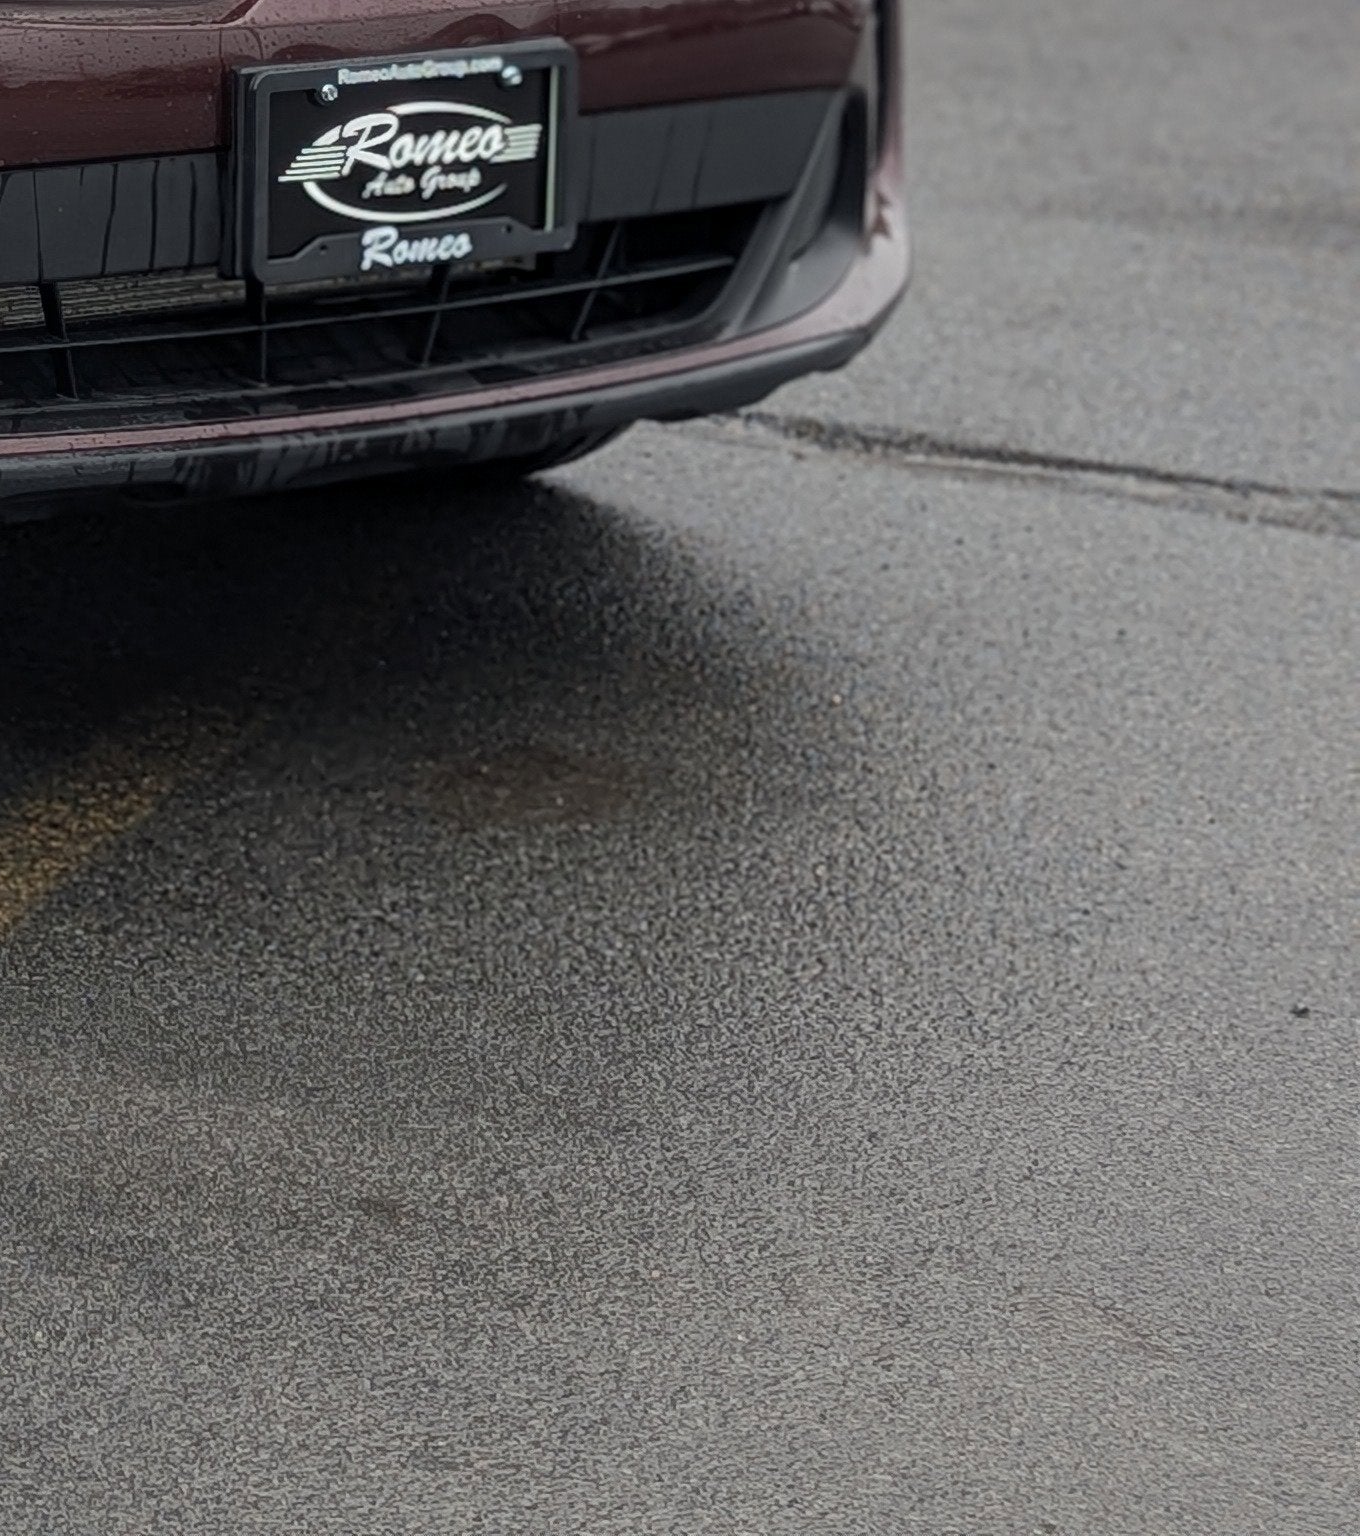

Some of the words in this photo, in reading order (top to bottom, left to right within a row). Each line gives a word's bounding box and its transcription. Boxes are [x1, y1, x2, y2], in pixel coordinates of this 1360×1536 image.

[341, 112, 506, 178] Romeo
[361, 171, 416, 200] Auto
[419, 165, 481, 200] Group
[360, 225, 474, 272] Romeo
